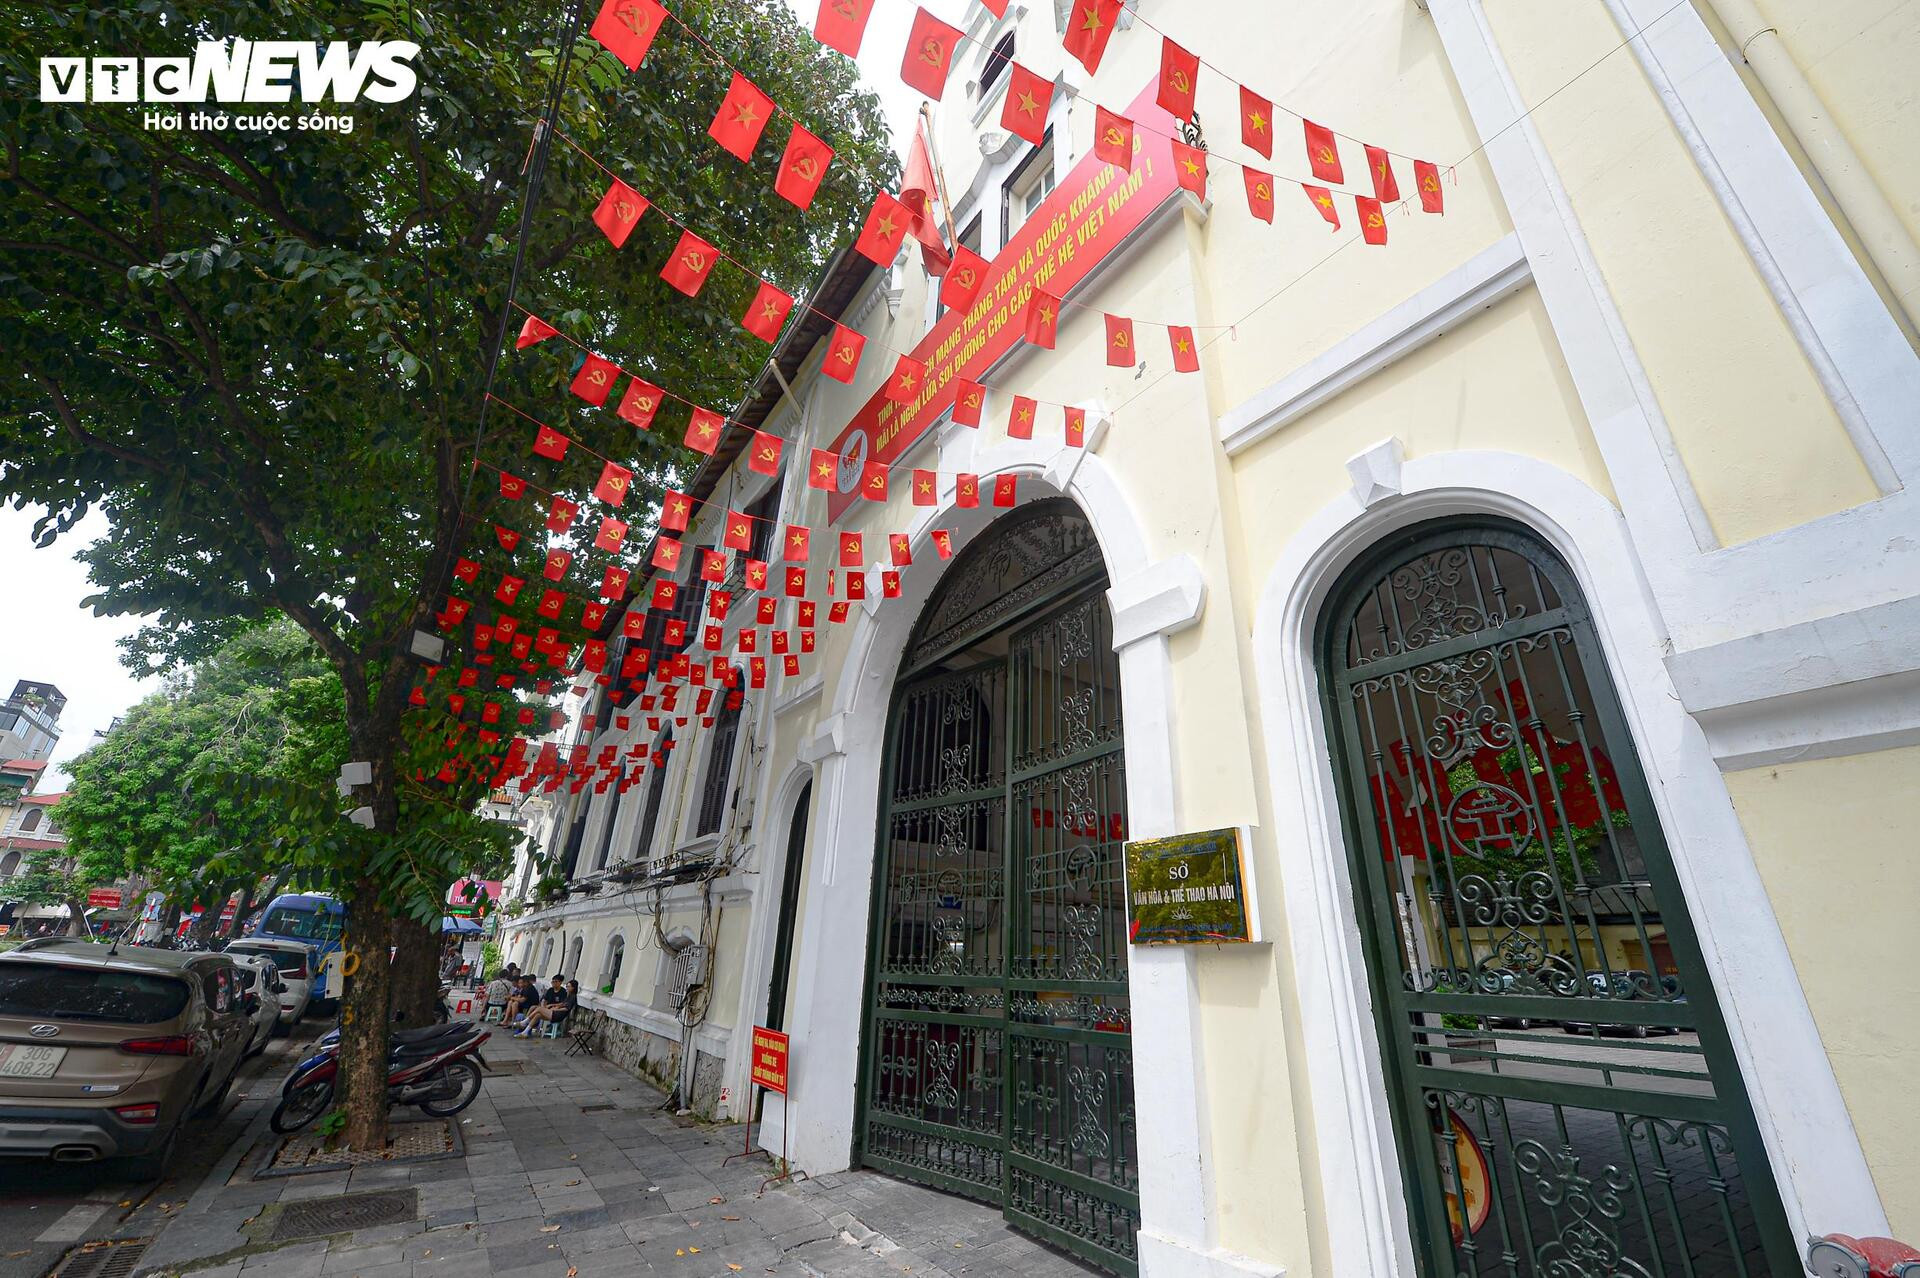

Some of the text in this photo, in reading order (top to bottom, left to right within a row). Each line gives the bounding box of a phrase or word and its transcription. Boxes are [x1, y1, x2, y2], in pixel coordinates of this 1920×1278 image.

[935, 326, 961, 365] MẠNG
[962, 292, 993, 336] THÁNG
[995, 265, 1017, 301] TÁM
[1018, 246, 1034, 275] VÀ
[1035, 212, 1068, 257] QUỐC
[1069, 163, 1115, 222] KHÁNH
[890, 416, 899, 439] LÀ
[938, 362, 953, 389] SOI
[954, 328, 986, 373] ĐƯỜNG
[987, 305, 1008, 338] CHO
[1009, 280, 1032, 316] CÁC
[1033, 248, 1056, 289] THẾ
[1057, 234, 1075, 268] HỆ
[1076, 204, 1105, 247] VIỆT
[1107, 167, 1143, 217] NAM
[1169, 860, 1189, 880] SỞ
[1164, 892, 1171, 904] &
[1186, 886, 1206, 903] THAO
[1207, 882, 1219, 900] HÀ
[1220, 881, 1235, 903] NỘI
[22, 1046, 54, 1060] 30G
[2, 1061, 56, 1076] 408.22
